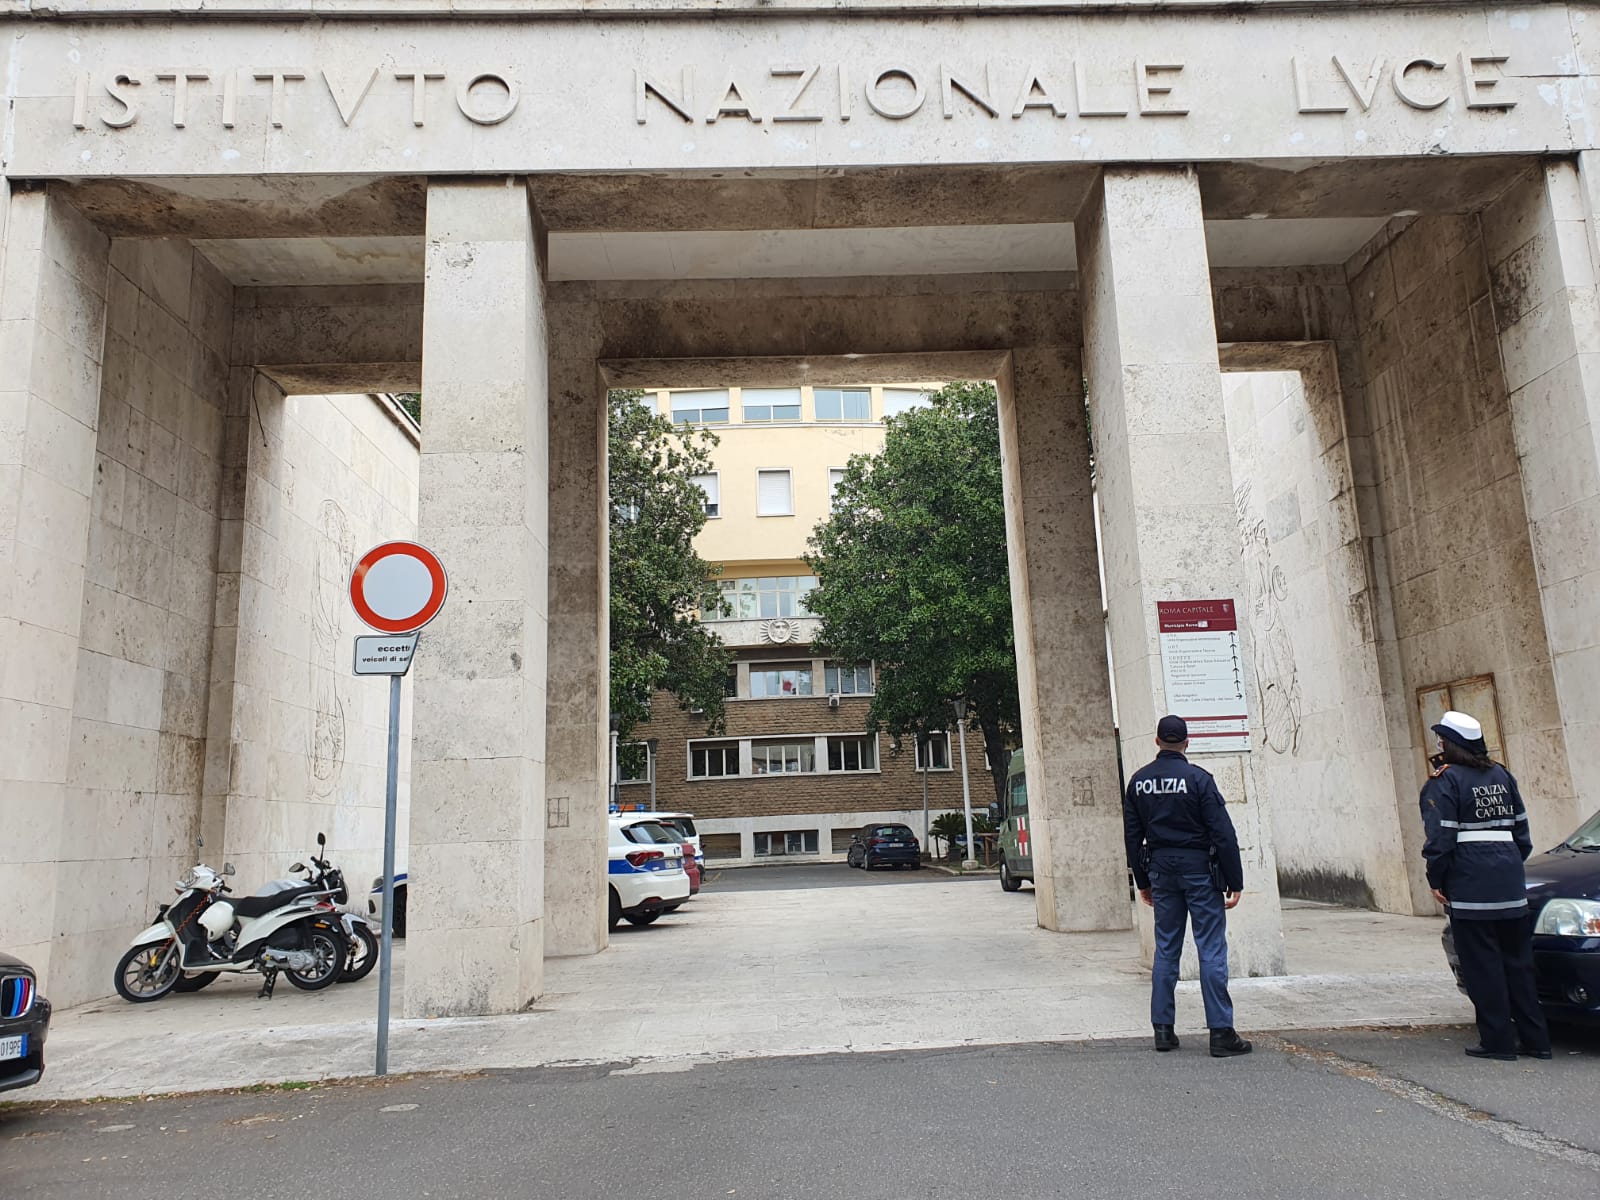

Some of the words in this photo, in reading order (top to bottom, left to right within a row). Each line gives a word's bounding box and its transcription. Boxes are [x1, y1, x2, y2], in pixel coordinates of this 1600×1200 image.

[71, 65, 521, 130] ISTITVTO
[634, 56, 1191, 126] NAZIONALE
[1291, 50, 1518, 114] LVCE
[1159, 607, 1181, 615] ROMA
[1182, 606, 1214, 614] CAPITALE
[362, 655, 388, 663] veicoli
[1135, 777, 1188, 796] POLIZIA
[1472, 783, 1508, 797] POLIZIA
[1475, 795, 1504, 808] ROMA
[1475, 805, 1514, 819] CAPITALE
